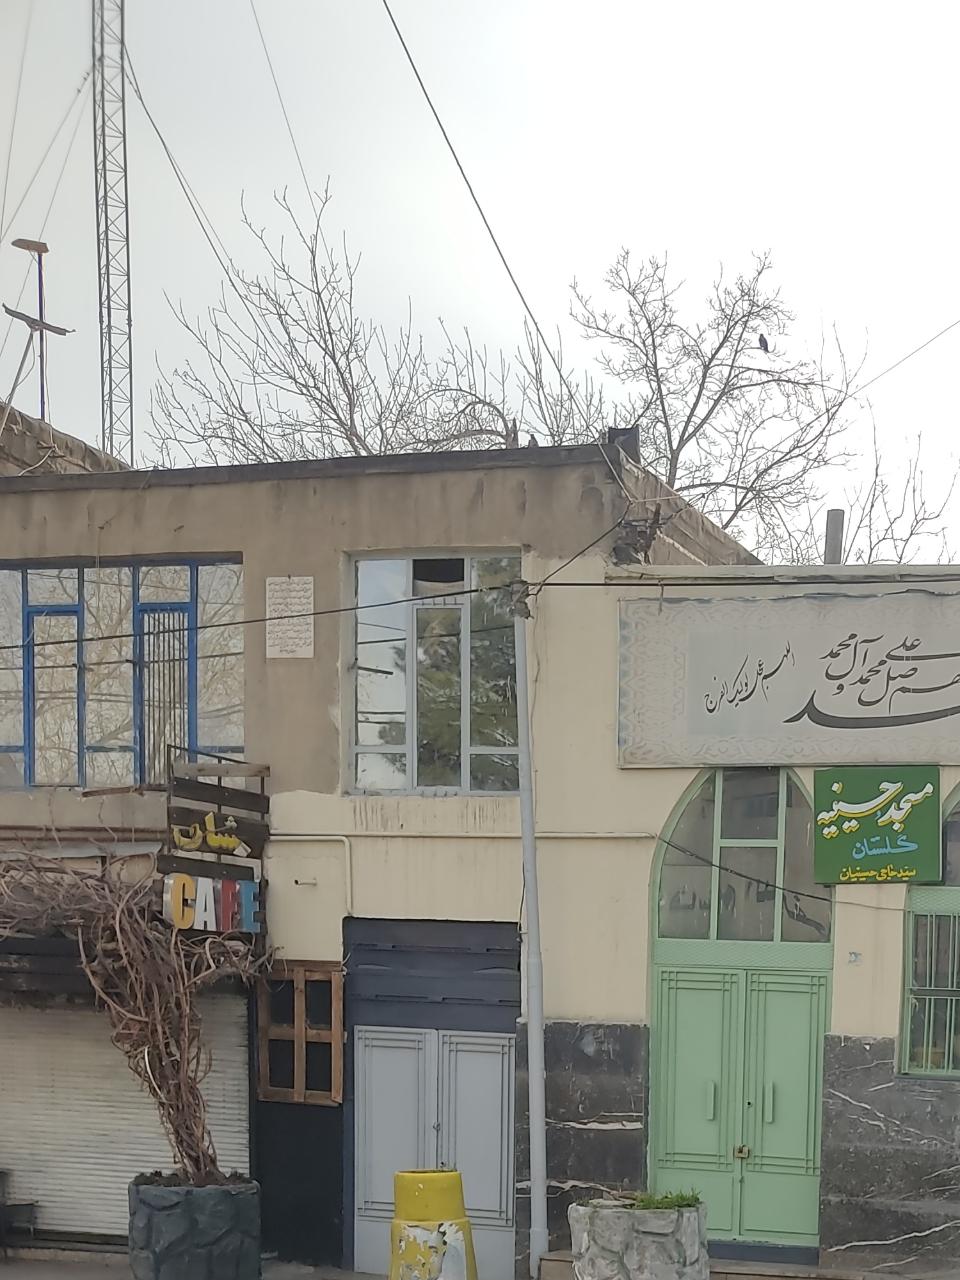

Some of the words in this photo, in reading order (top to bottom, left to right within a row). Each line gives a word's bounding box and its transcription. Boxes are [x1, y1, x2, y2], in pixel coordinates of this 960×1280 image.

[818, 633, 858, 660] محمد
[848, 659, 888, 686] محمد
[817, 781, 904, 839] حسینیه
[877, 783, 934, 832] مسجد
[852, 835, 919, 860] گلستان
[168, 873, 260, 933] CAFE
